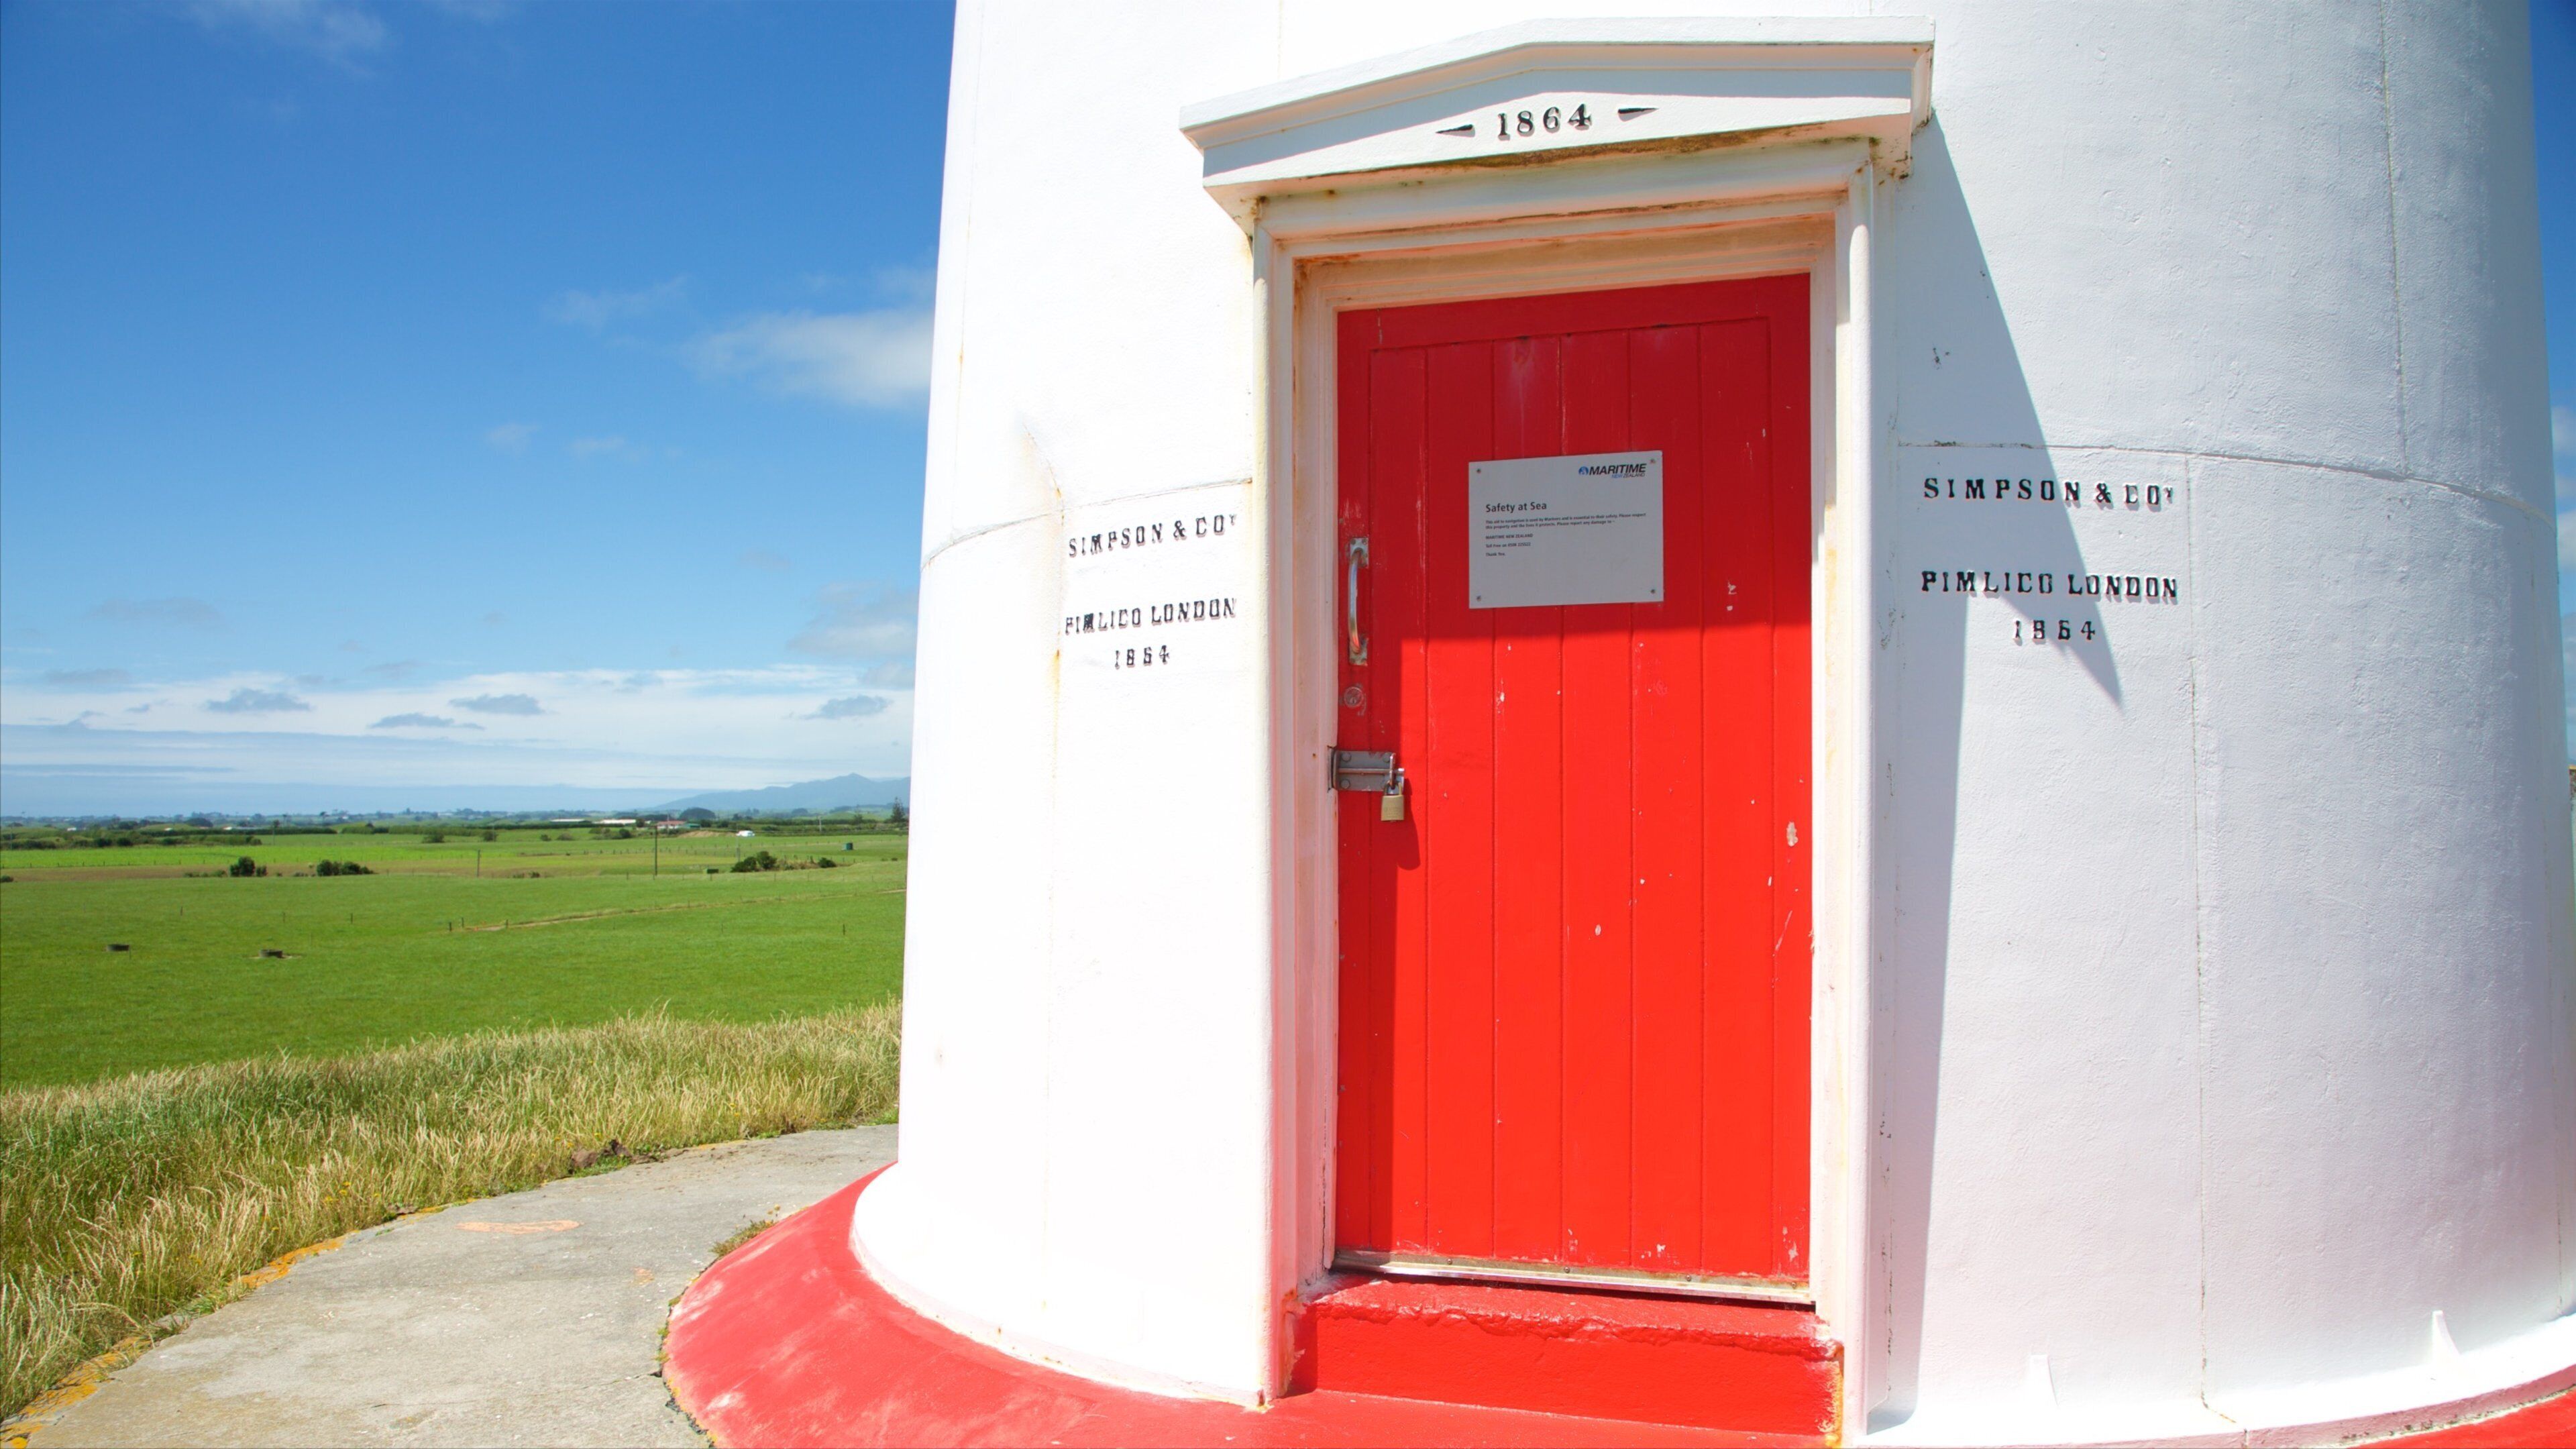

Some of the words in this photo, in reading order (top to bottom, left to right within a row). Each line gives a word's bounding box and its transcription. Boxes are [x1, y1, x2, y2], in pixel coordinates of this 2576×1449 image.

[1497, 103, 1591, 136] 1864
[1589, 464, 1647, 476] MARITIME
[1923, 477, 2080, 502] SIMPSON
[2095, 482, 2112, 504] &
[1485, 502, 1515, 513] Safety
[1518, 503, 1527, 511] at
[1530, 501, 1547, 511] Sea
[1069, 523, 1163, 557] SIMPSON
[1173, 520, 1186, 539] &
[1921, 571, 2053, 594] PIMLICO
[2068, 574, 2177, 598] LONDON
[1065, 608, 1141, 635] PIMLICO
[1151, 598, 1236, 625] LONDON
[2014, 620, 2096, 641] 1864
[1115, 645, 1169, 669] 1864
